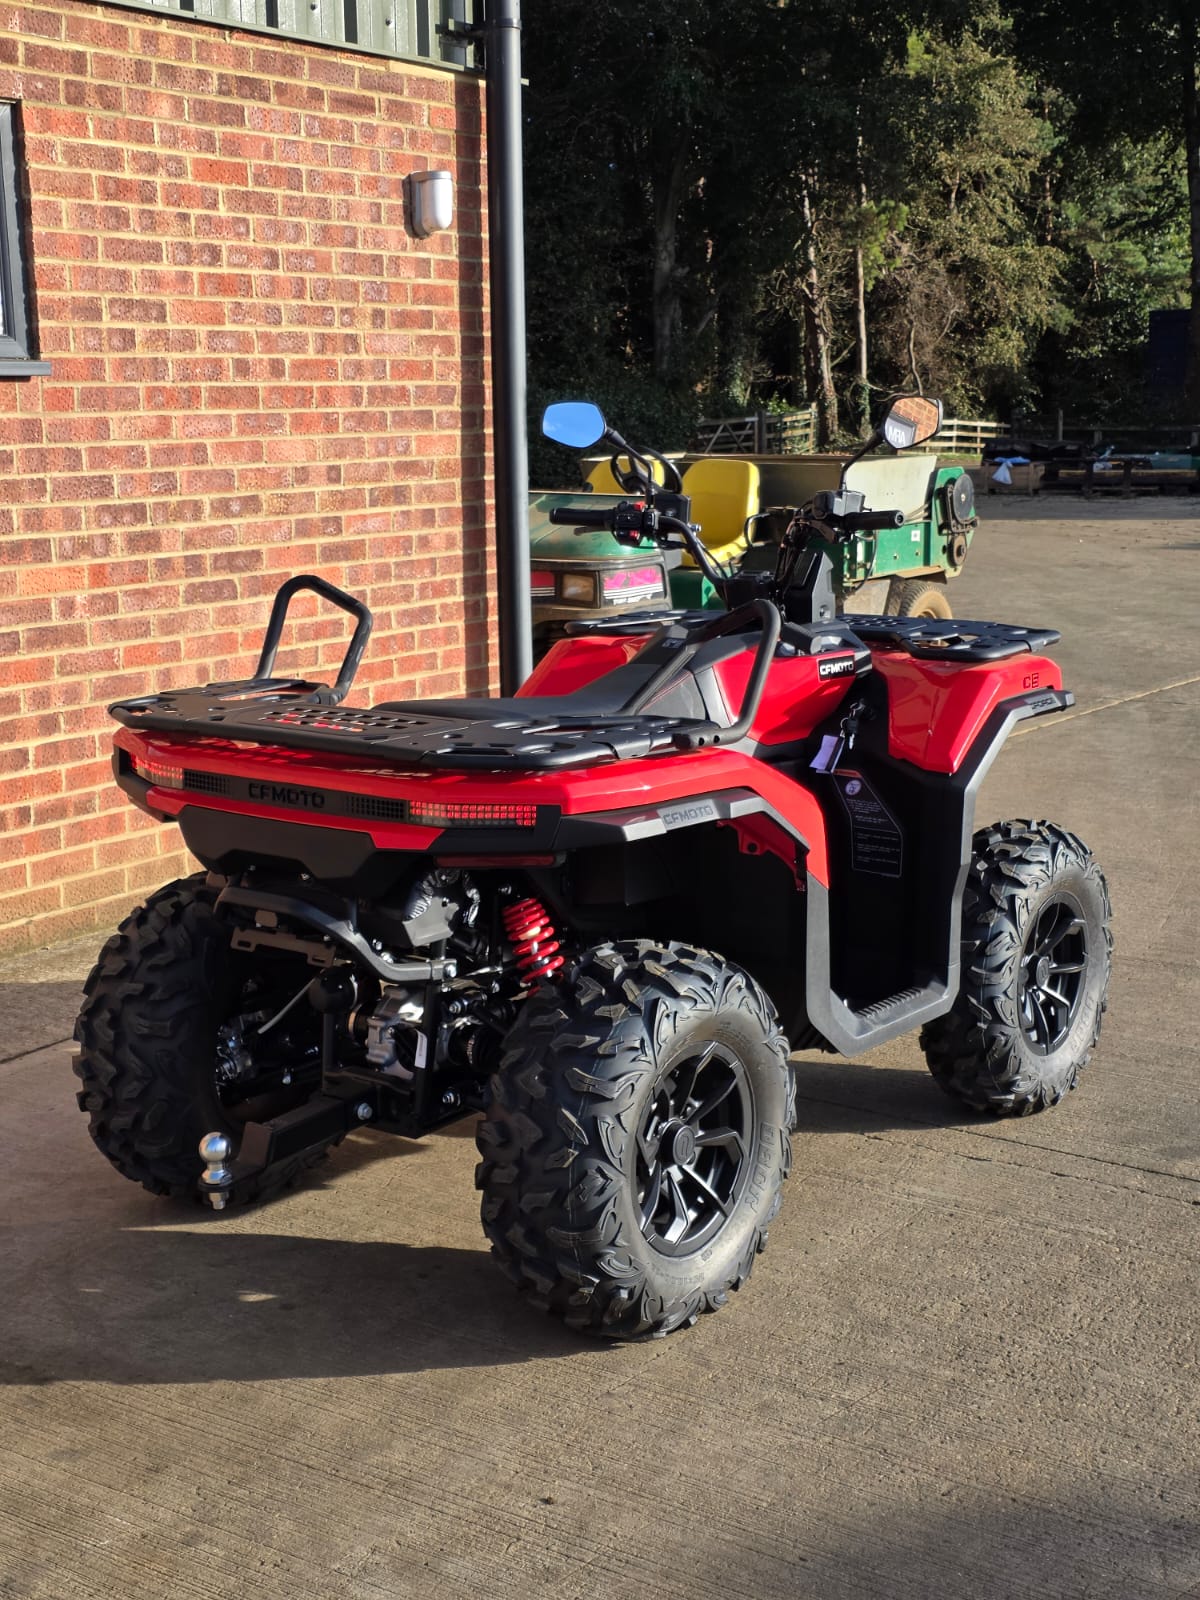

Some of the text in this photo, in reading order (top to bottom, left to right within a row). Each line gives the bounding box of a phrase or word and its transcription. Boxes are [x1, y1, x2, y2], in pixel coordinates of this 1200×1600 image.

[819, 661, 854, 675] CFMOTO
[248, 782, 325, 808] CFMOTO
[662, 805, 714, 825] CFMOTO
